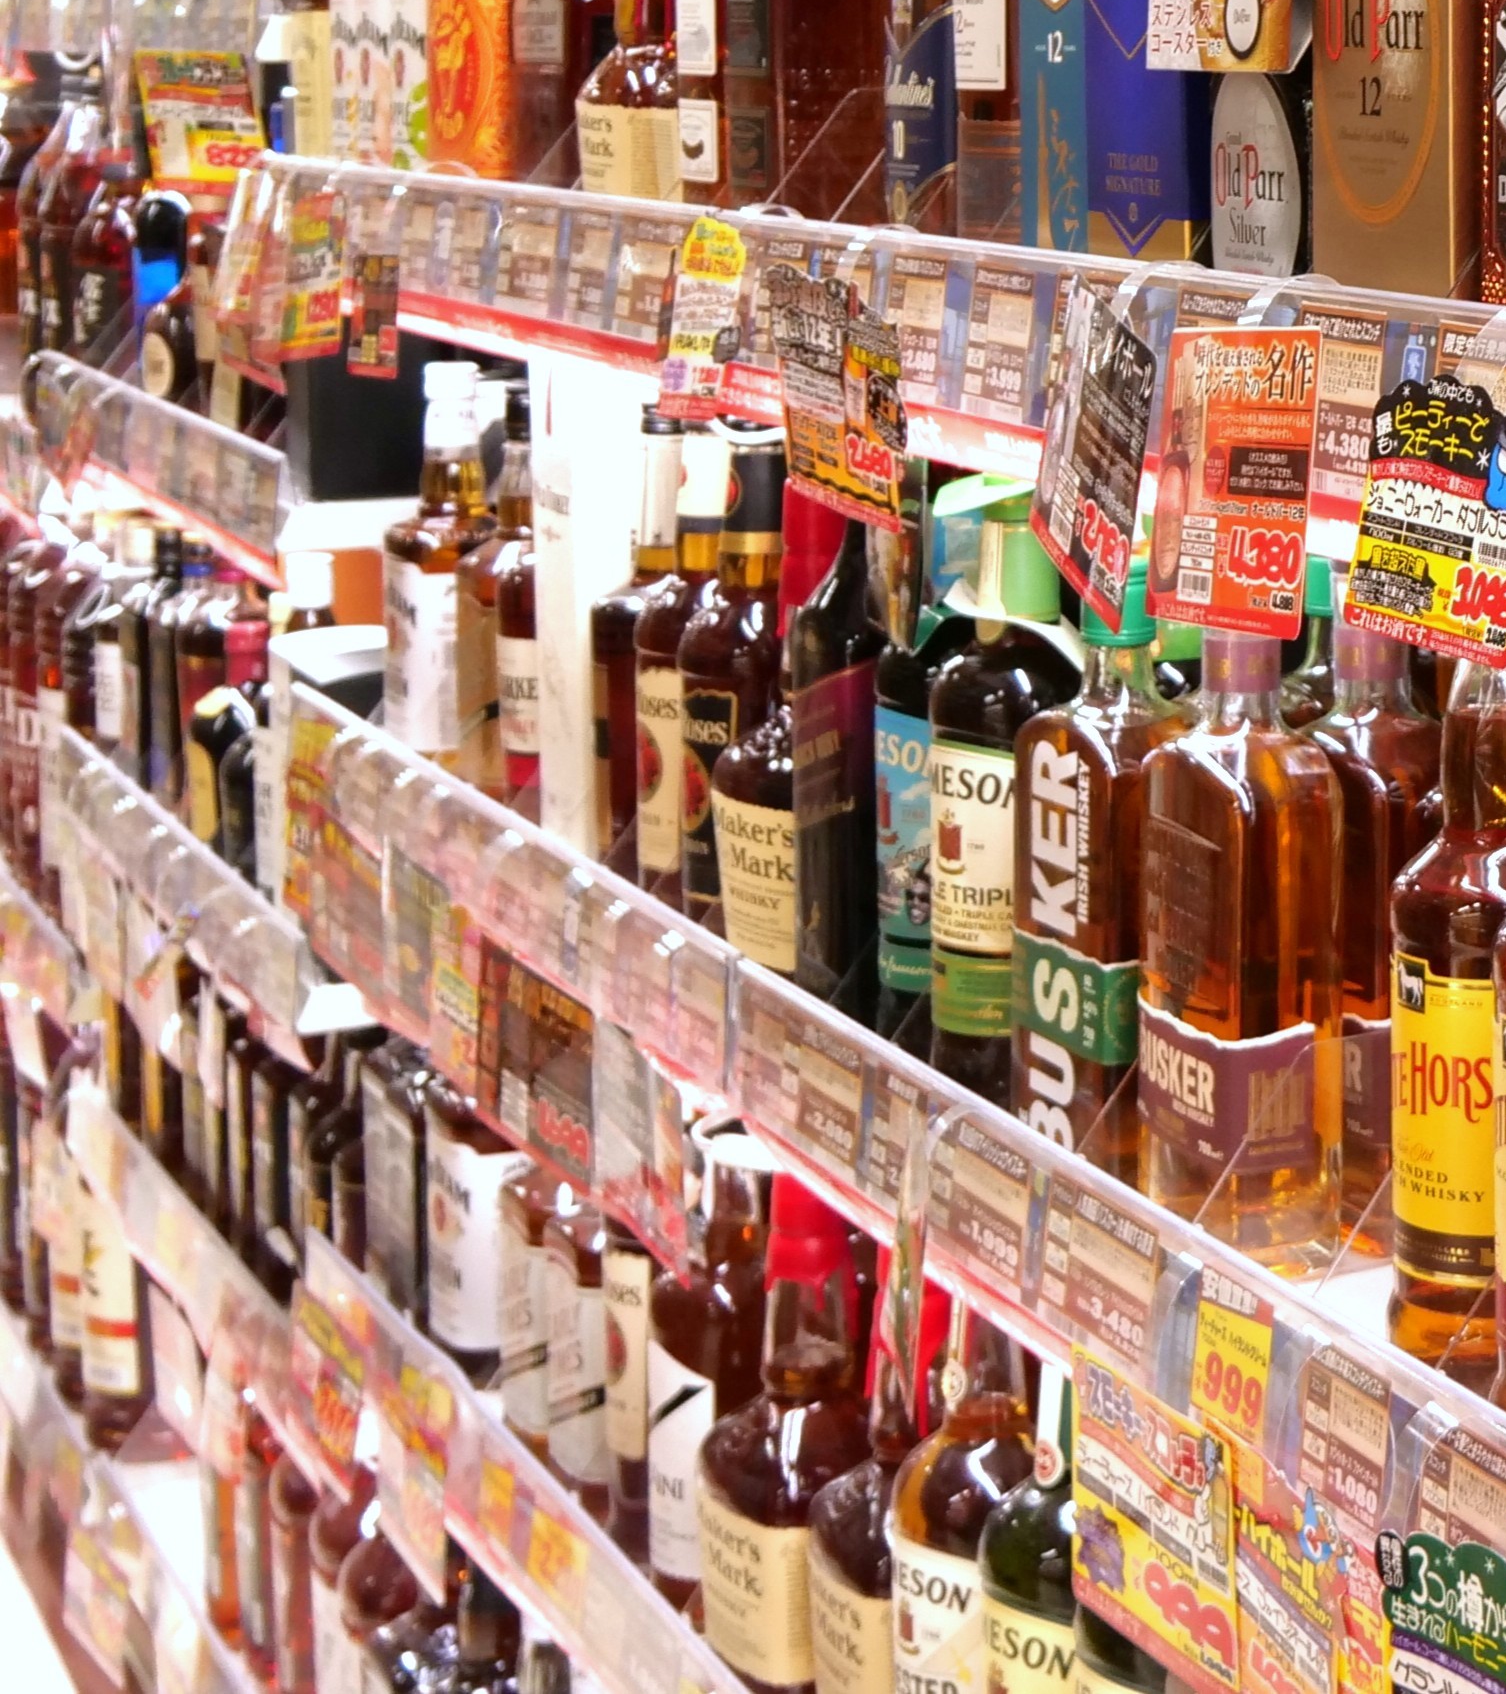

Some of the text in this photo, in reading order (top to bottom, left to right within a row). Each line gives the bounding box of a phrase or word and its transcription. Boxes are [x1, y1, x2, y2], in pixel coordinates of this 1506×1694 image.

[1152, 3, 1212, 28] ステンレス
[1047, 30, 1063, 64] 12
[1359, 76, 1382, 117] 12
[1229, 207, 1266, 247] Silver
[1264, 342, 1314, 405] 名作
[1395, 401, 1490, 443] ピーティーで
[1401, 430, 1474, 462] スモーキー
[1349, 608, 1428, 644] これはお酒です。
